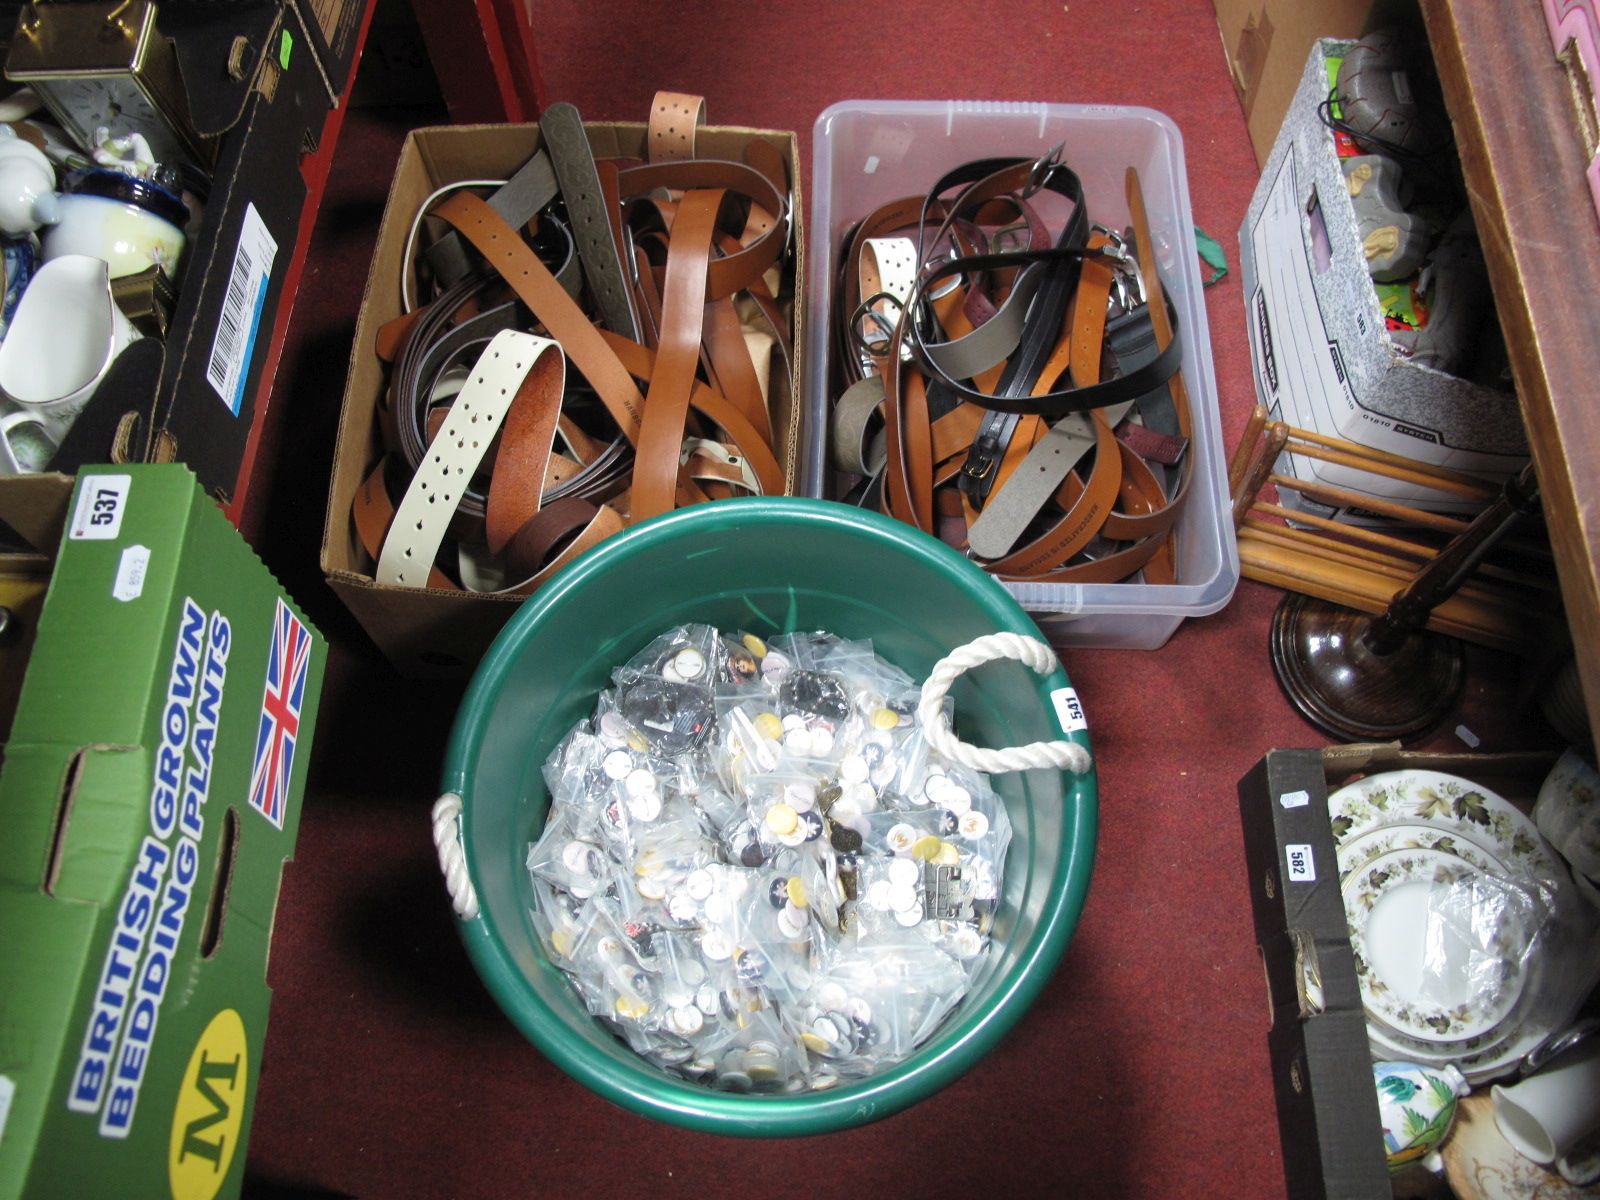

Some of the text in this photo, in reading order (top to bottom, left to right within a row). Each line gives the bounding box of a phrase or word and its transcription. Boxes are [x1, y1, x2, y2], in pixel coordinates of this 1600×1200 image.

[91, 489, 119, 526] 537
[1064, 697, 1083, 720] 541
[74, 603, 206, 1103] BRITISH GROWN
[105, 616, 231, 1129] BEDDING PLANTS
[1291, 851, 1306, 874] 582
[178, 1050, 241, 1174] M
